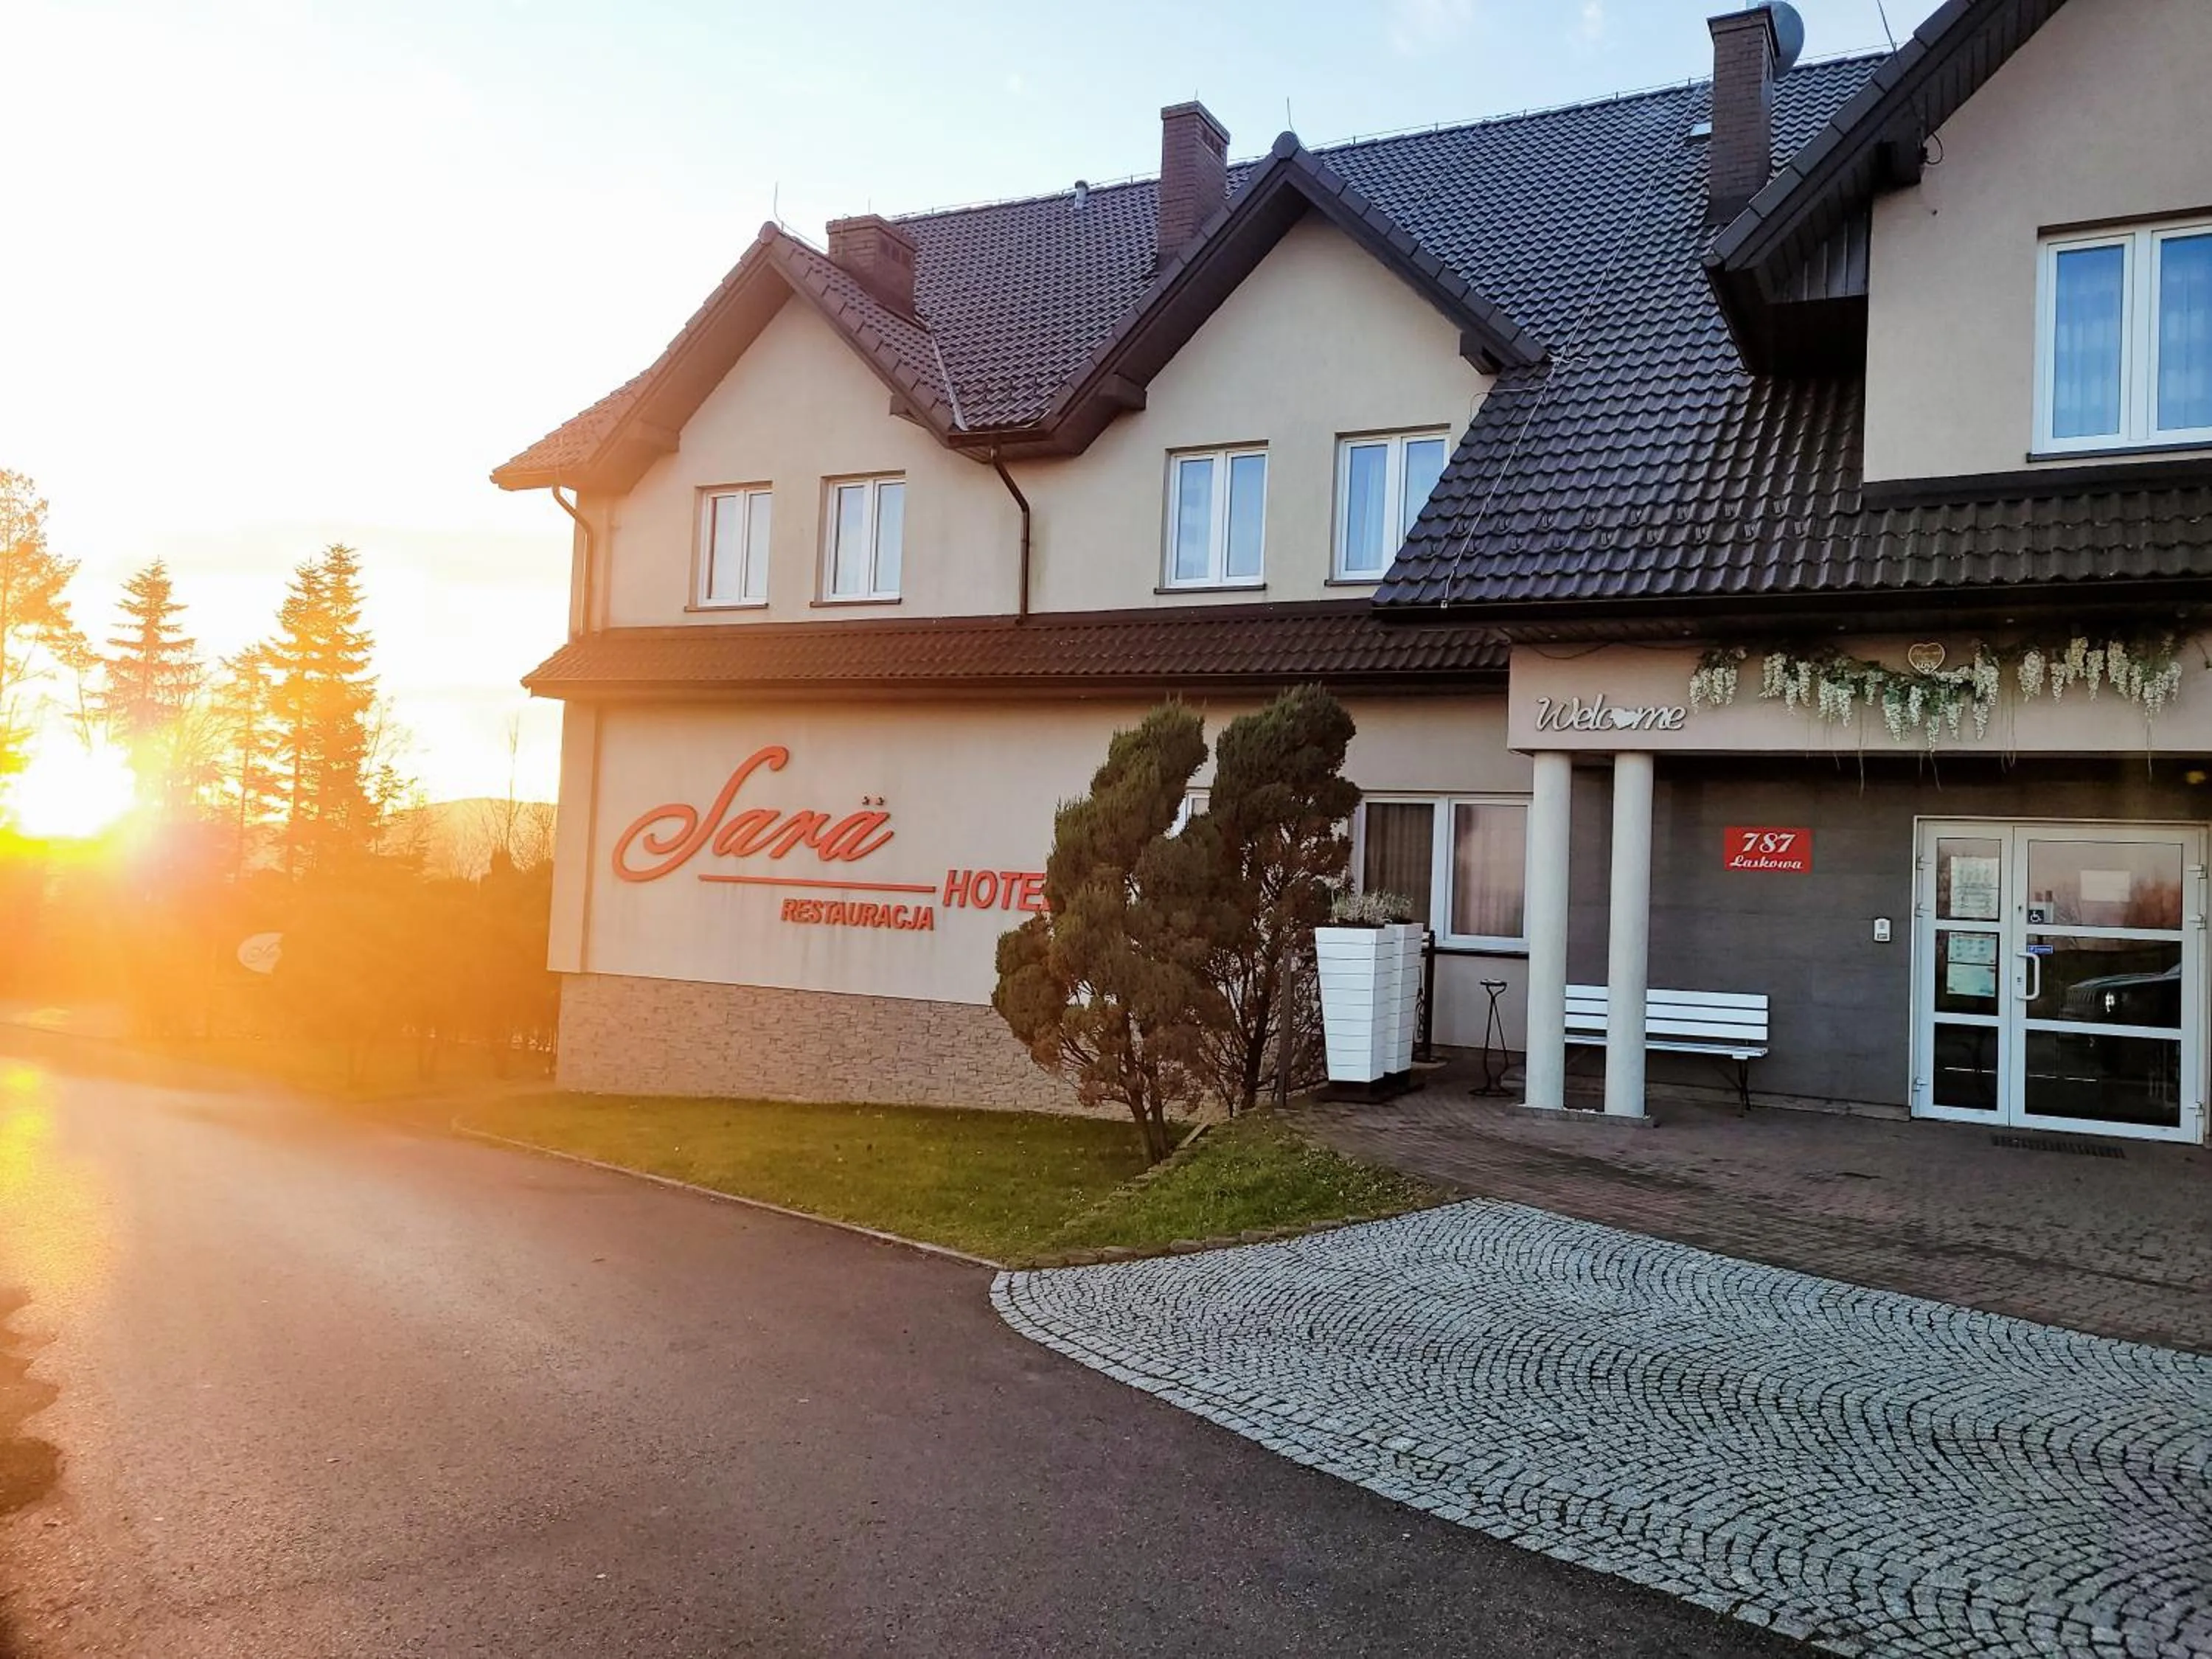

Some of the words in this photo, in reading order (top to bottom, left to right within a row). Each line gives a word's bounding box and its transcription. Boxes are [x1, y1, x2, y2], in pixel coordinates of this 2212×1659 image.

[1742, 832, 1796, 853] 787
[1729, 855, 1803, 869] Laskowa
[943, 869, 1051, 912] HOTE
[781, 898, 934, 931] RESTAURACJA
